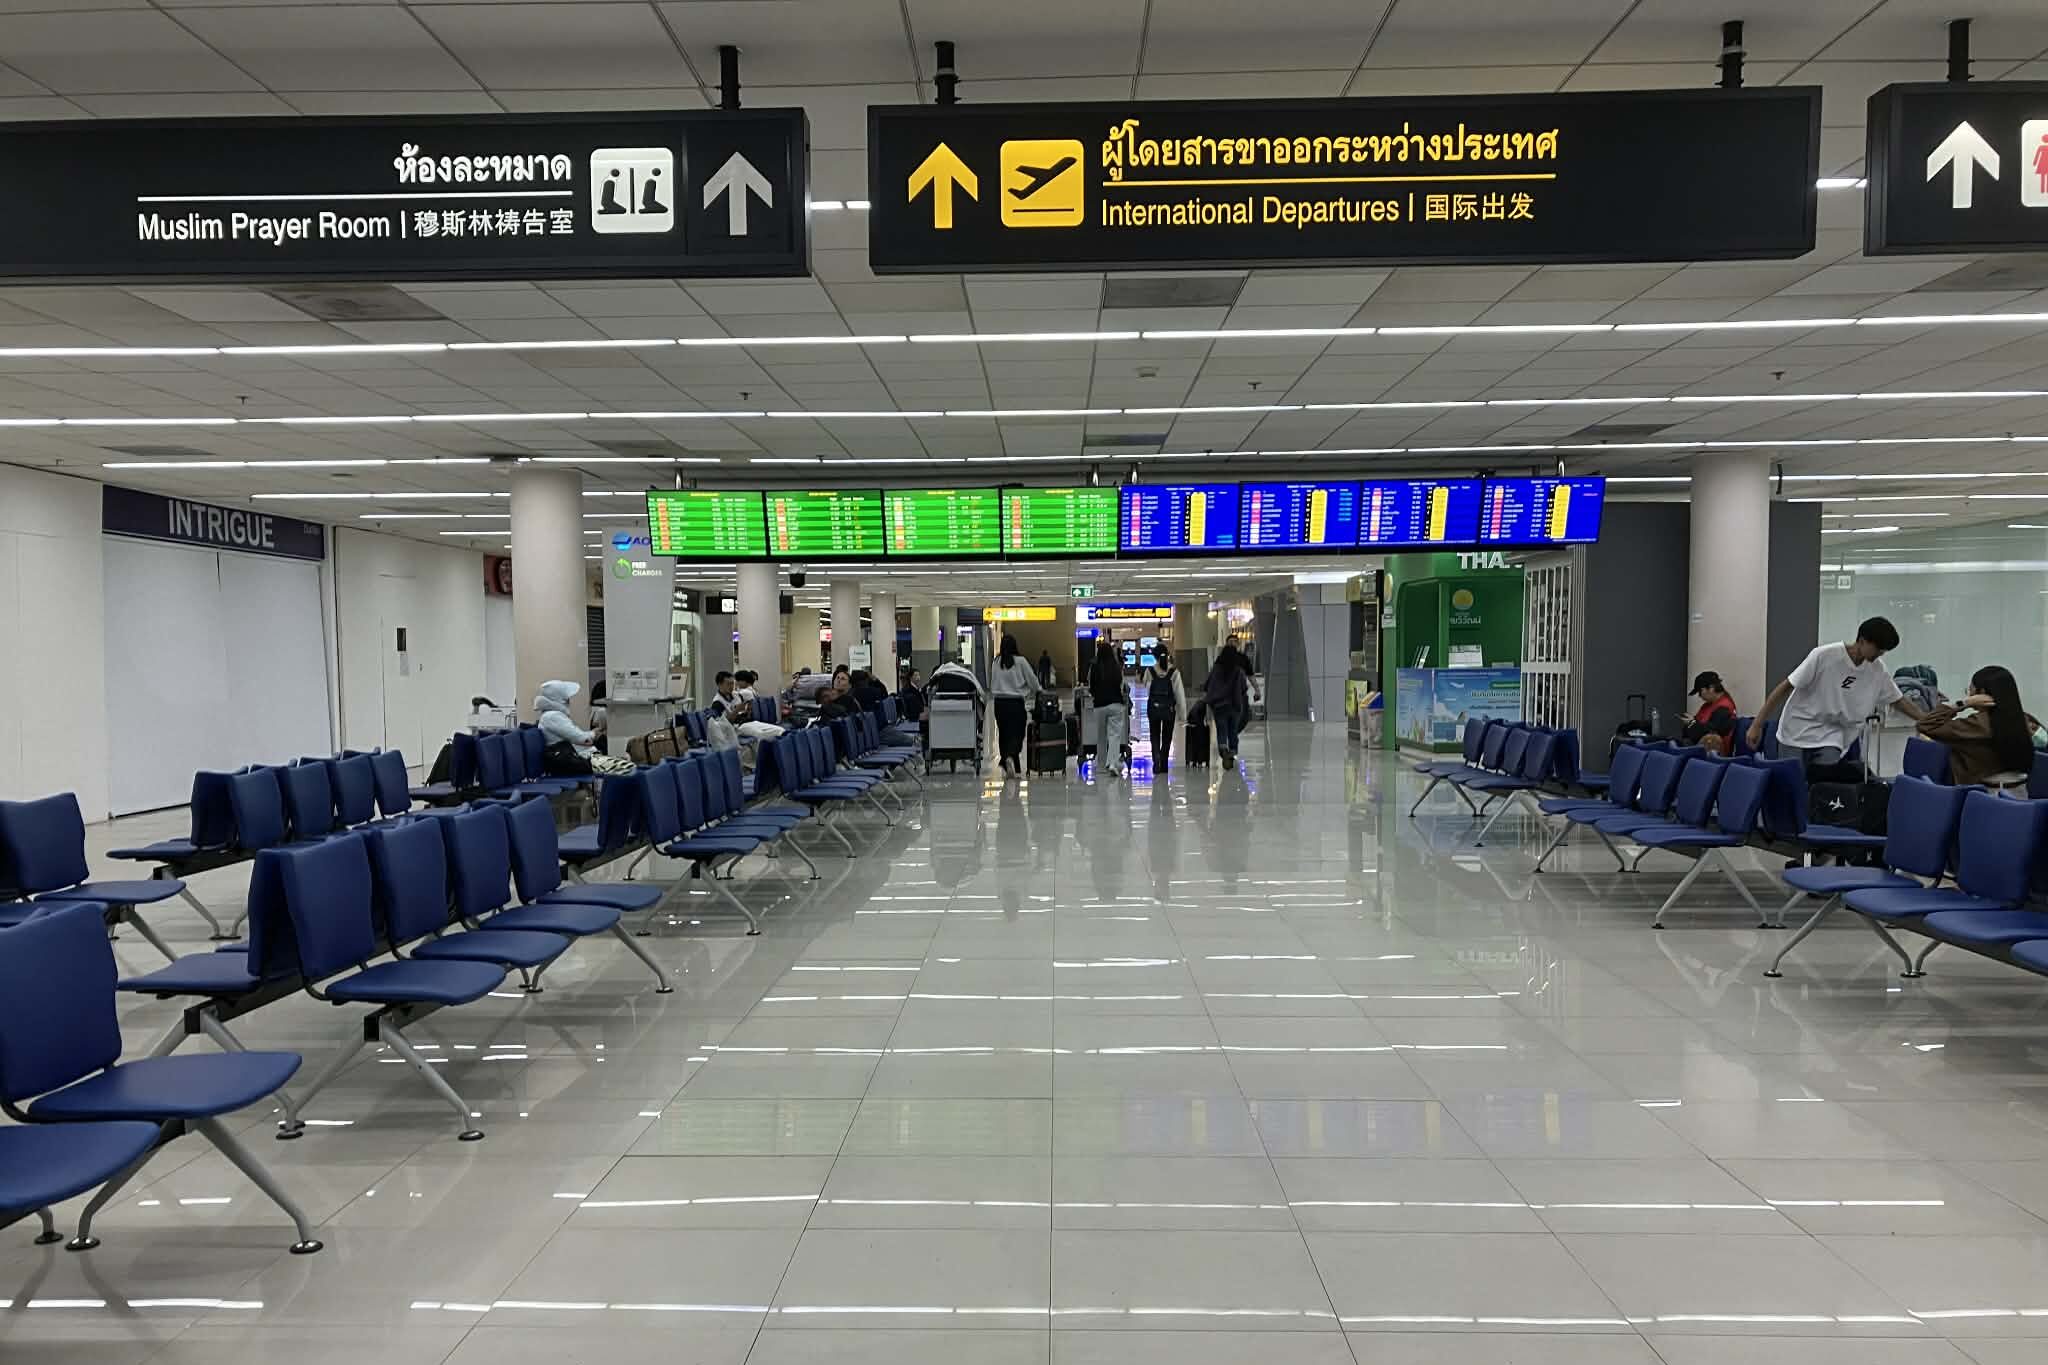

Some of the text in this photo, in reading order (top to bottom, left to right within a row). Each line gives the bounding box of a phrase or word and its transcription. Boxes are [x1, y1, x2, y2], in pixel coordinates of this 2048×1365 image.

[393, 143, 572, 184] ห้องละหมาด
[1102, 119, 1559, 182] ผู้โดยสารขาออกระหว่างประเทศ
[413, 207, 574, 238] 穆斯林祷告室
[1102, 192, 1400, 229] International Departures
[1425, 190, 1535, 222] 国际出发
[137, 209, 391, 246] Muslim Prayer Room
[168, 500, 274, 548] INTRIGUE
[632, 536, 651, 546] AO
